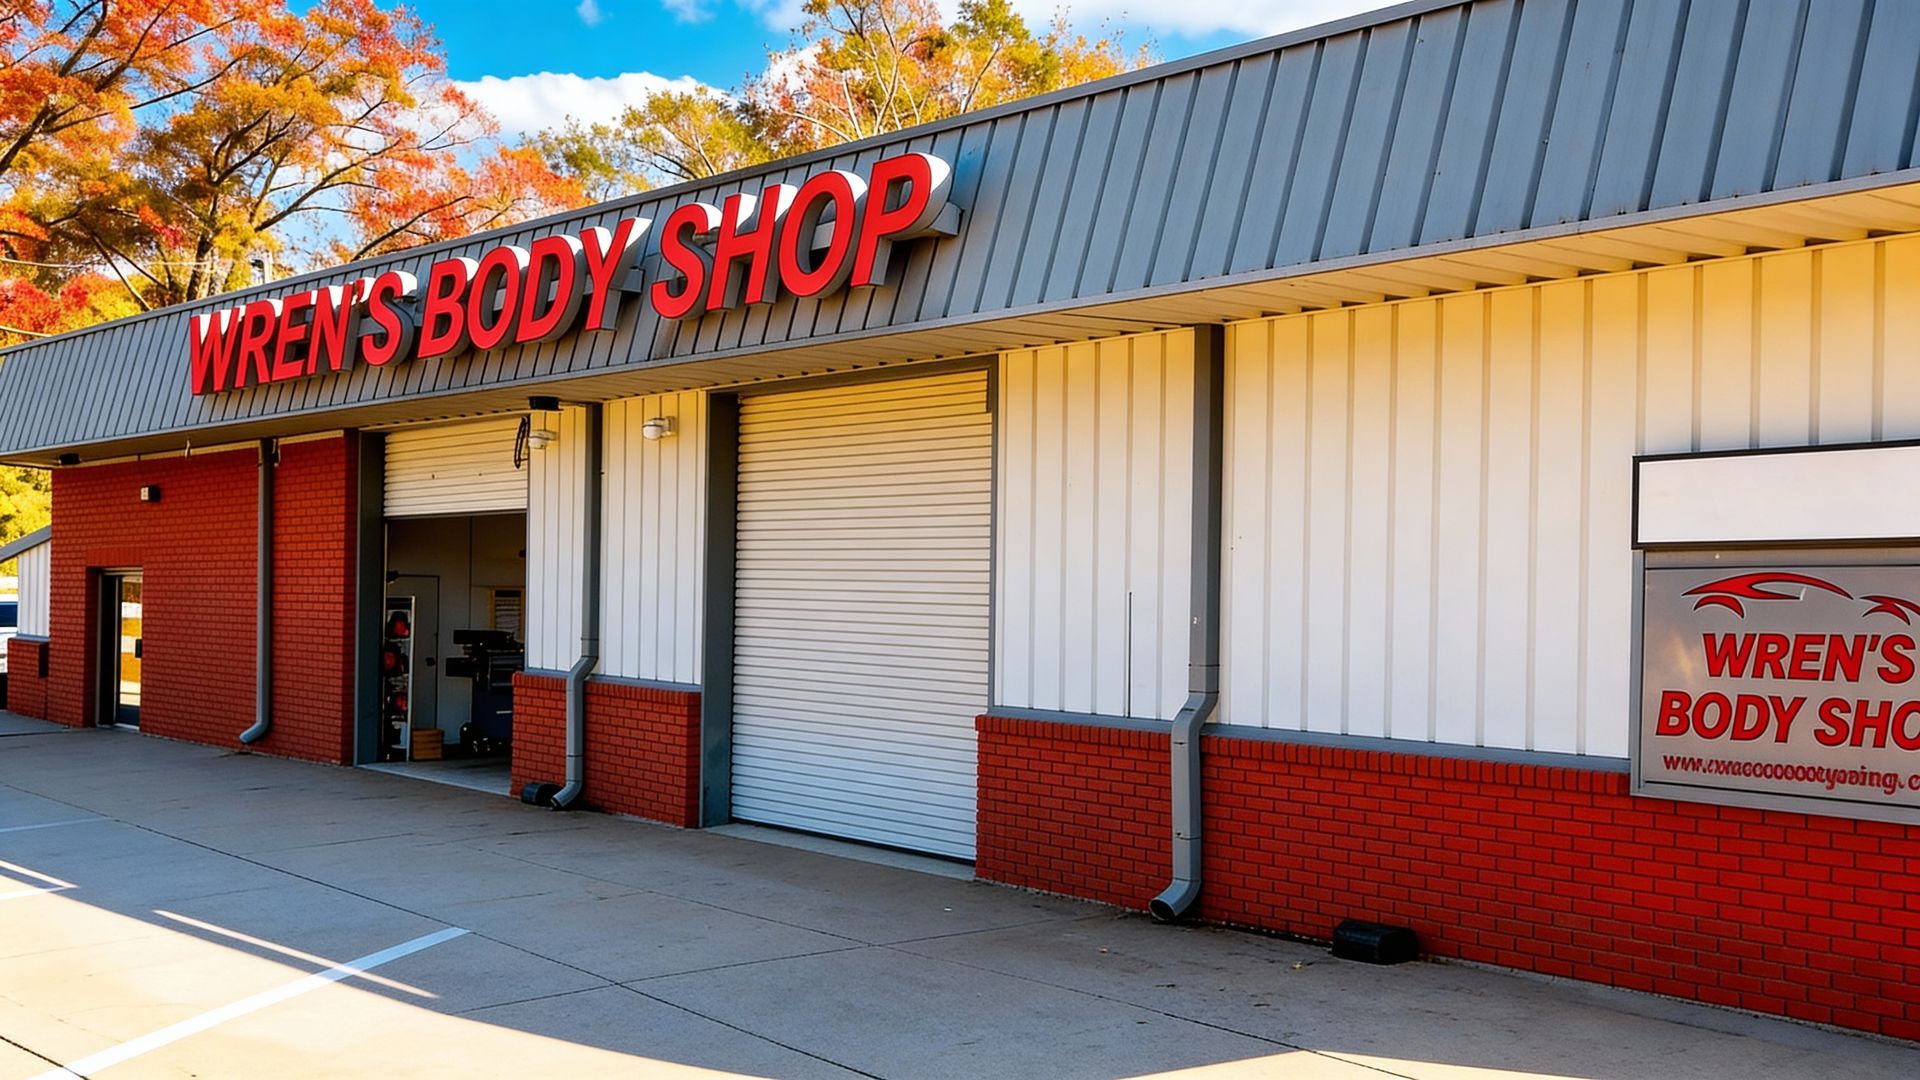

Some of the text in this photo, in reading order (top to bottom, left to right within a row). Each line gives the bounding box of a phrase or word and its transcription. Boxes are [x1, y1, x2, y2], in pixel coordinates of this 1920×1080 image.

[190, 153, 933, 395] WREN'S BODY SHOP
[1702, 633, 1917, 684] WREN'S
[1655, 690, 1808, 743] BODY
